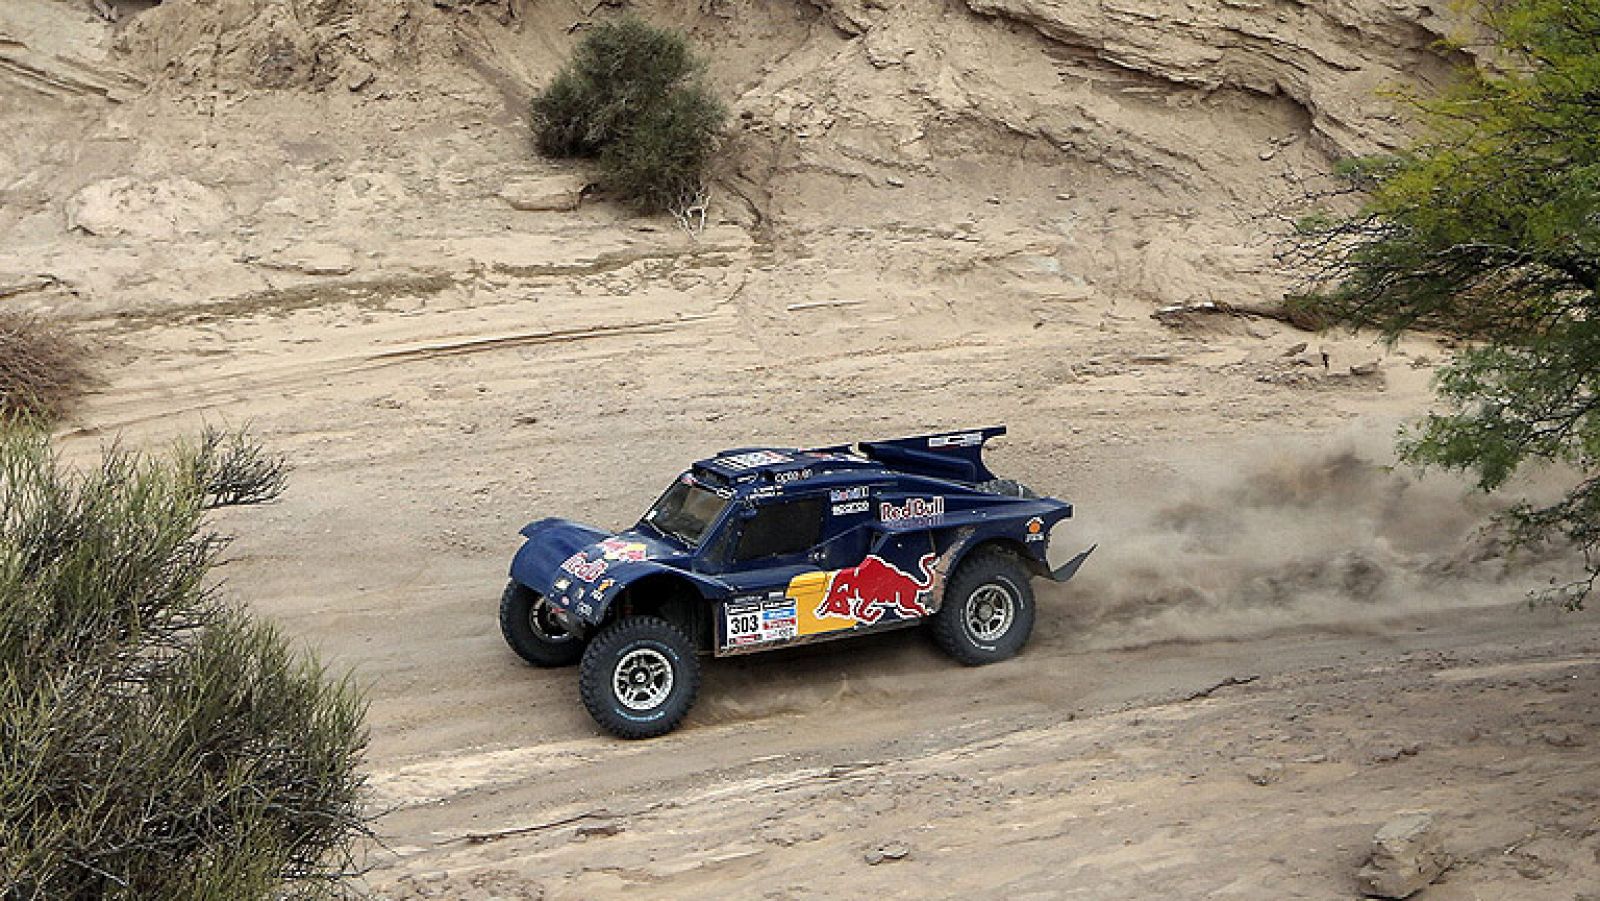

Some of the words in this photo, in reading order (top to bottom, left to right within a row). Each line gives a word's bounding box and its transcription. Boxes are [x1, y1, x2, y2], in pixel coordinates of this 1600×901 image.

[880, 498, 912, 522] Red
[912, 495, 945, 518] Bull
[730, 614, 759, 635] 303
